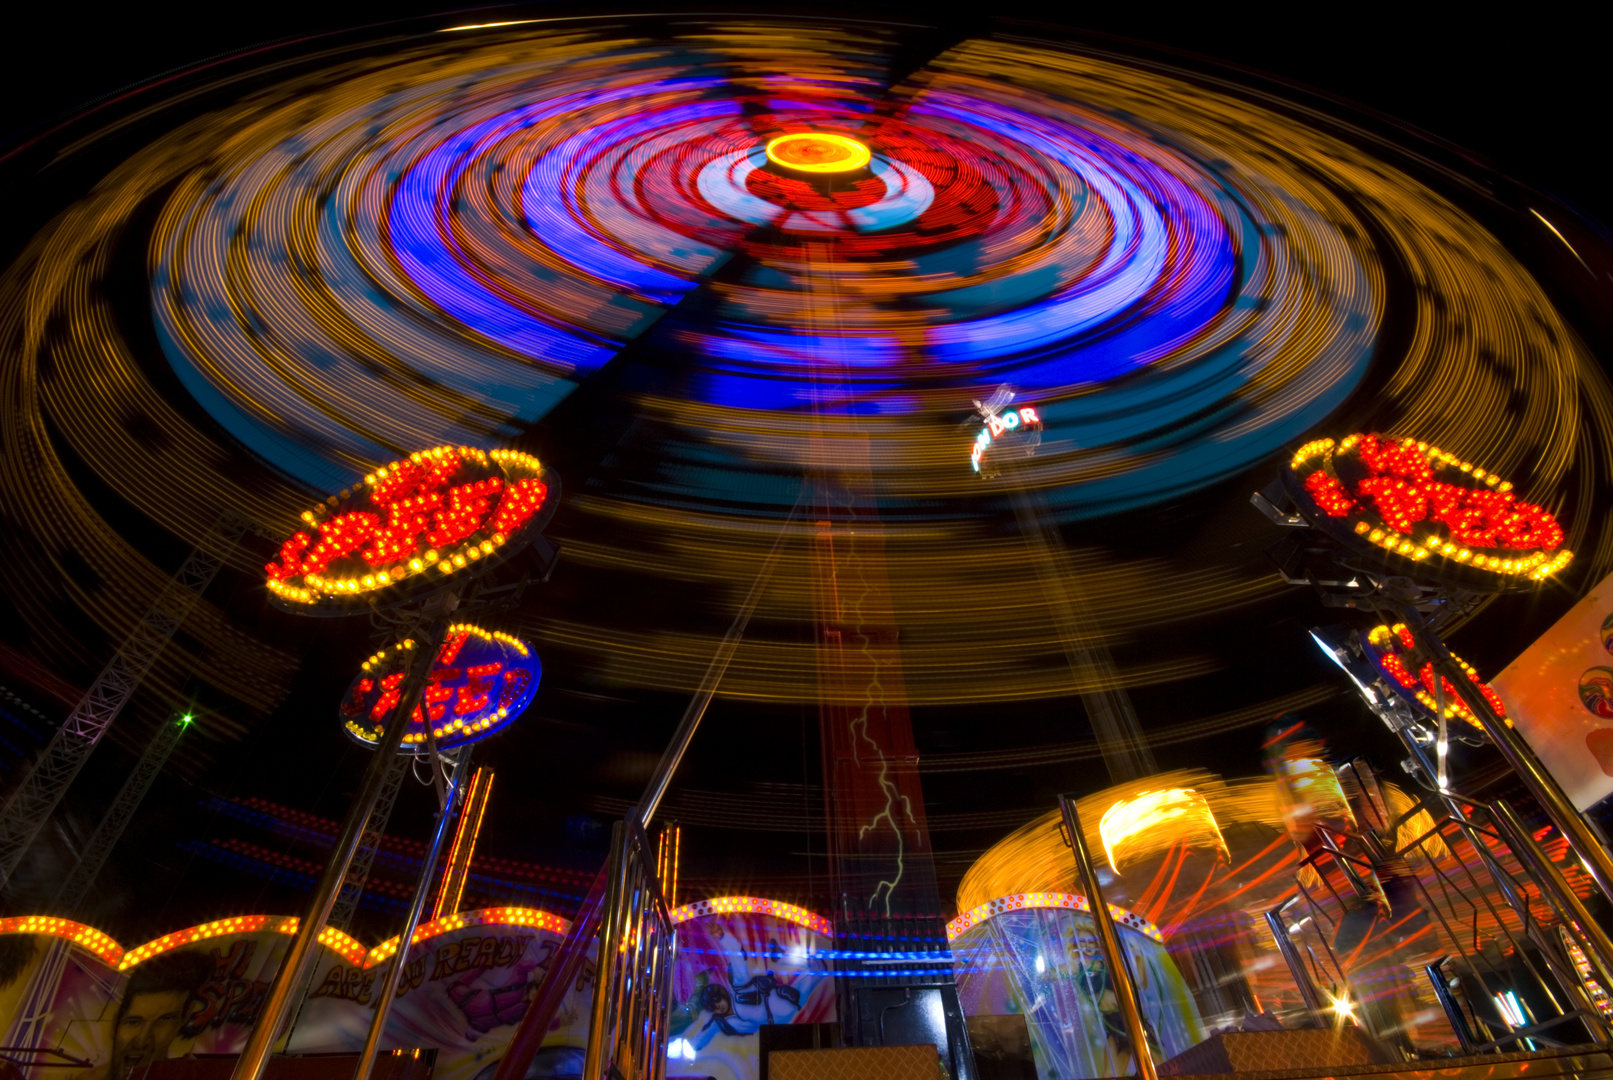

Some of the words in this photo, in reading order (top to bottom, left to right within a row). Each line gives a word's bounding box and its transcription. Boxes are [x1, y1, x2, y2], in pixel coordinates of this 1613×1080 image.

[264, 476, 548, 584] SPEED
[309, 964, 377, 1006] ARE
[370, 954, 429, 1009] OU
[428, 935, 535, 982] READY
